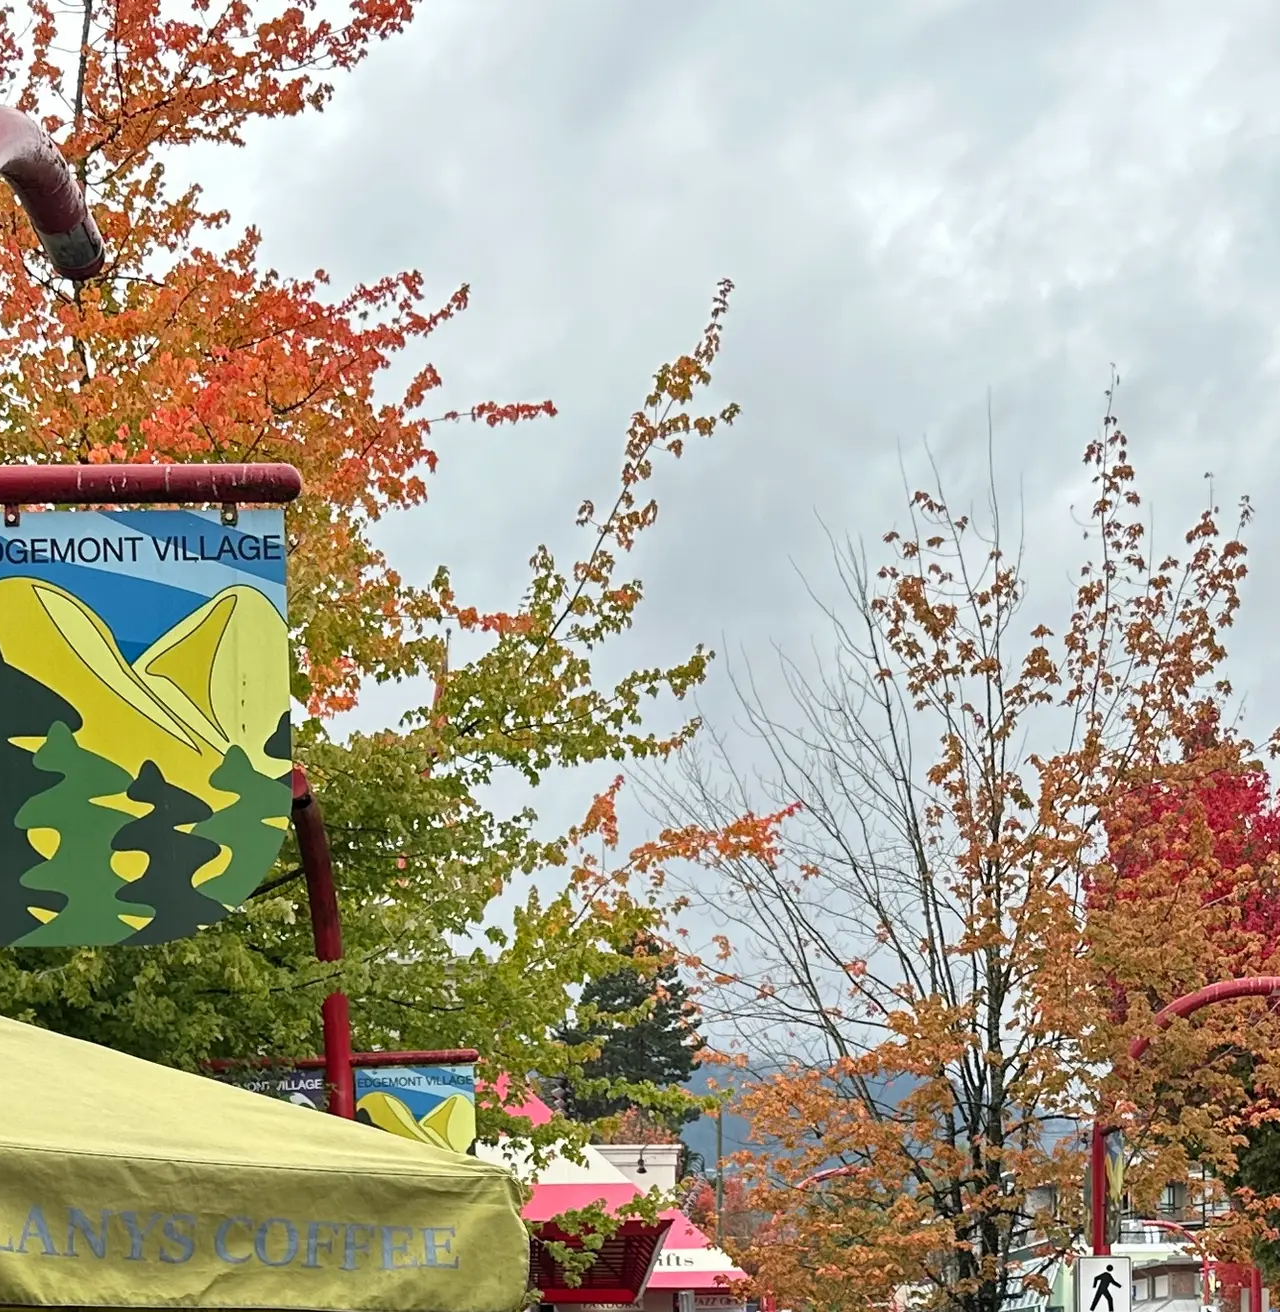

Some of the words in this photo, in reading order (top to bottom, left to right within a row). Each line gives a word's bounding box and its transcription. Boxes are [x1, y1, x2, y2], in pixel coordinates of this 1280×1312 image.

[151, 535, 281, 563] VILLAGE
[358, 1077, 422, 1088] EDGEMONT
[425, 1075, 473, 1086] VILLAGE
[214, 1215, 460, 1271] COFFEE
